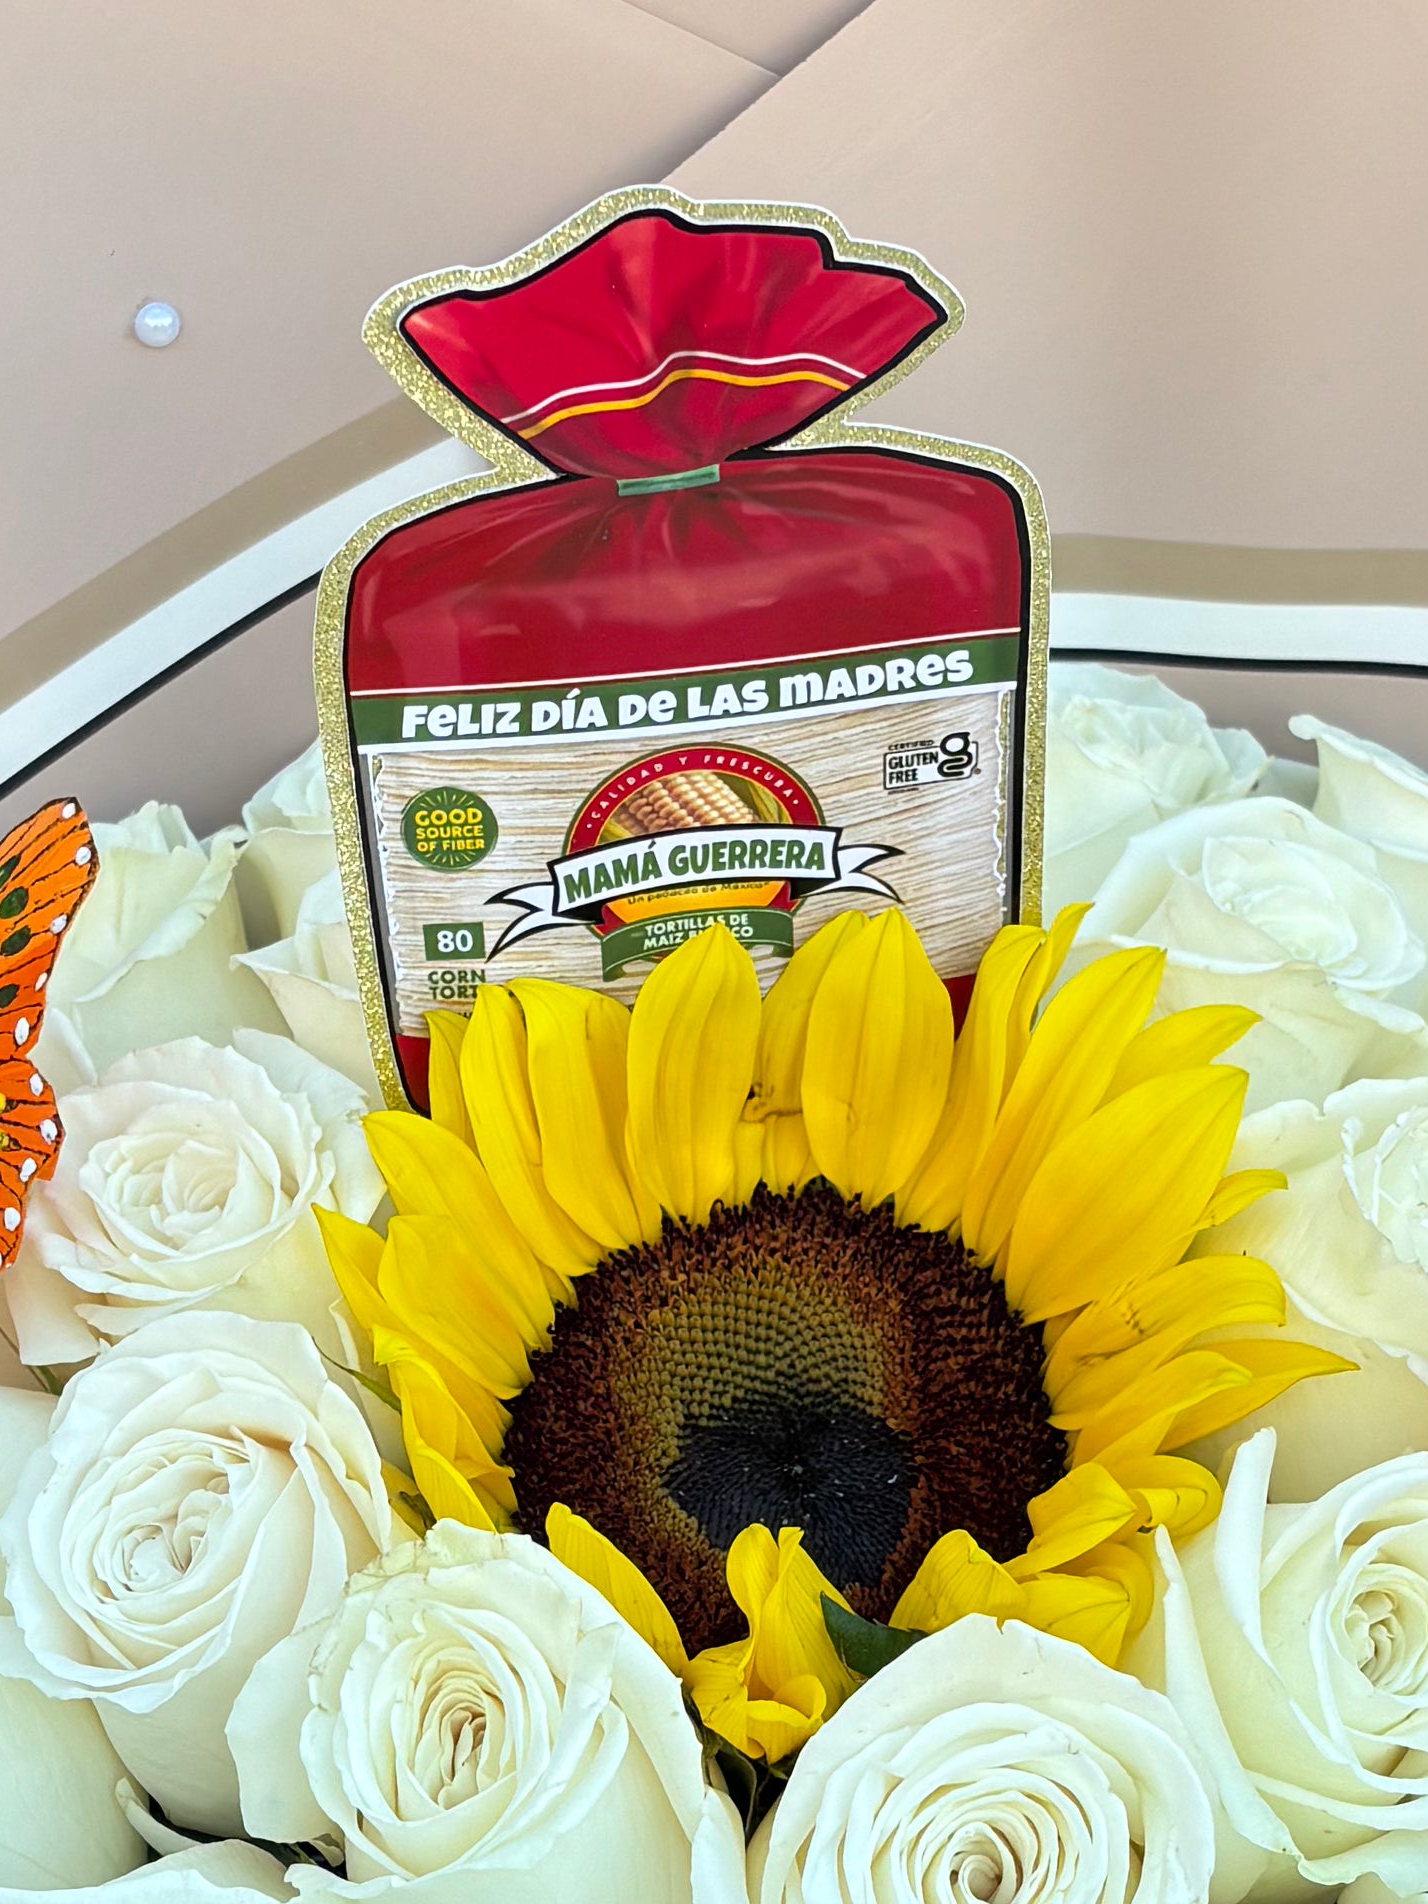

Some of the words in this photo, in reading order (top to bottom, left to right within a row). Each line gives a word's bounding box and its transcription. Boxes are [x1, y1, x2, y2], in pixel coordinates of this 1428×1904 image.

[531, 688, 608, 733] DÍA
[686, 680, 769, 720] LAS
[888, 751, 939, 770] GLUTEN
[888, 768, 918, 784] FREE
[590, 762, 664, 820] CALIDAD
[679, 756, 688, 766] Y
[703, 754, 795, 799] FRESCURA
[415, 808, 482, 826] GOOD
[416, 825, 484, 839] SOURCE
[417, 840, 437, 852] OF
[442, 839, 485, 851] FIBER
[563, 838, 663, 904] MAMÁ
[667, 839, 826, 876] GUERRERA
[645, 914, 726, 938] TORTILLAS
[729, 913, 749, 926] DE
[437, 930, 473, 953] 80
[643, 932, 684, 951] MAIZ
[428, 969, 486, 985] CORN
